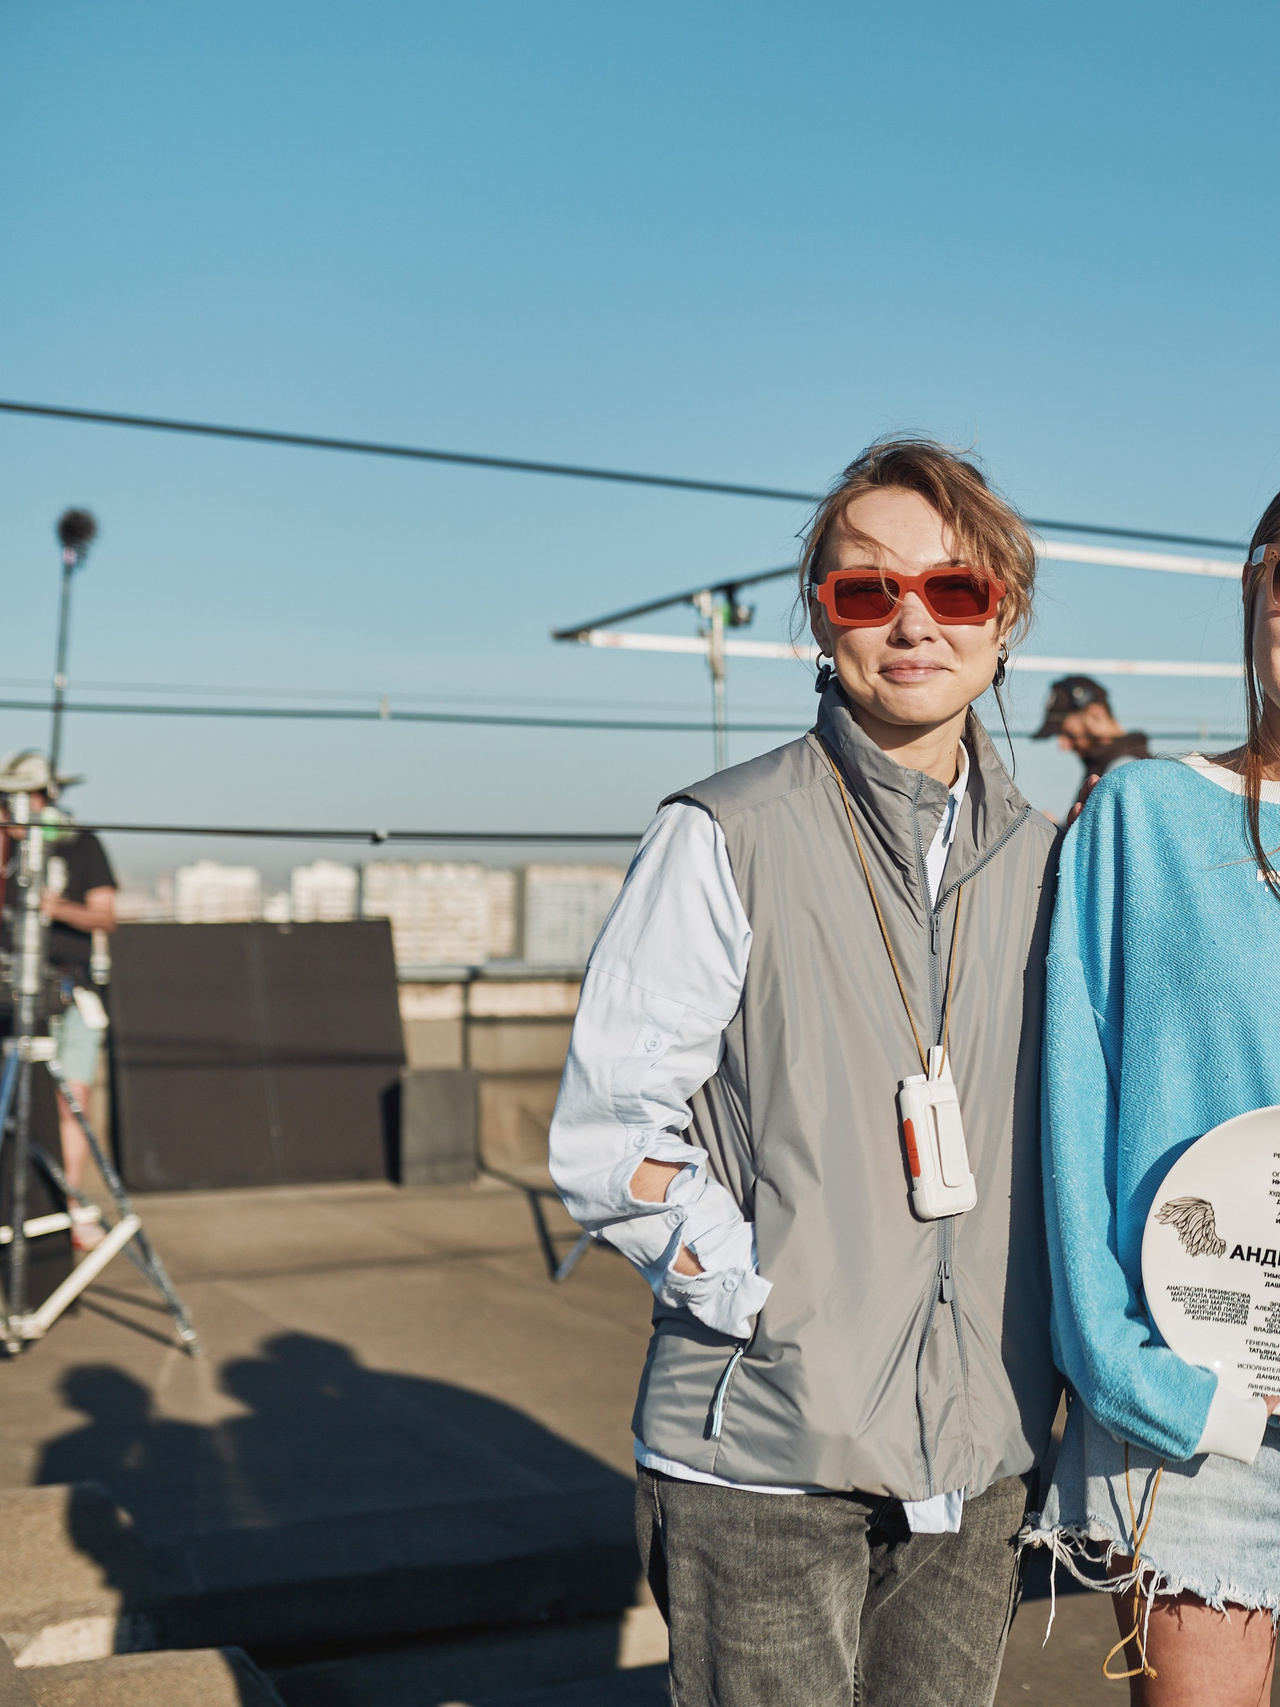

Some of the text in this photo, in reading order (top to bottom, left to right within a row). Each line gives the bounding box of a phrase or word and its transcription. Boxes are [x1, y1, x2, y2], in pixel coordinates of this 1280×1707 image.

[1166, 1285, 1251, 1299] АНАСТАСИЯ НИКИФОРОВА
[1212, 1317, 1247, 1326] НИКИТИНА
[1249, 1347, 1276, 1356] ТАТЬЯНА
